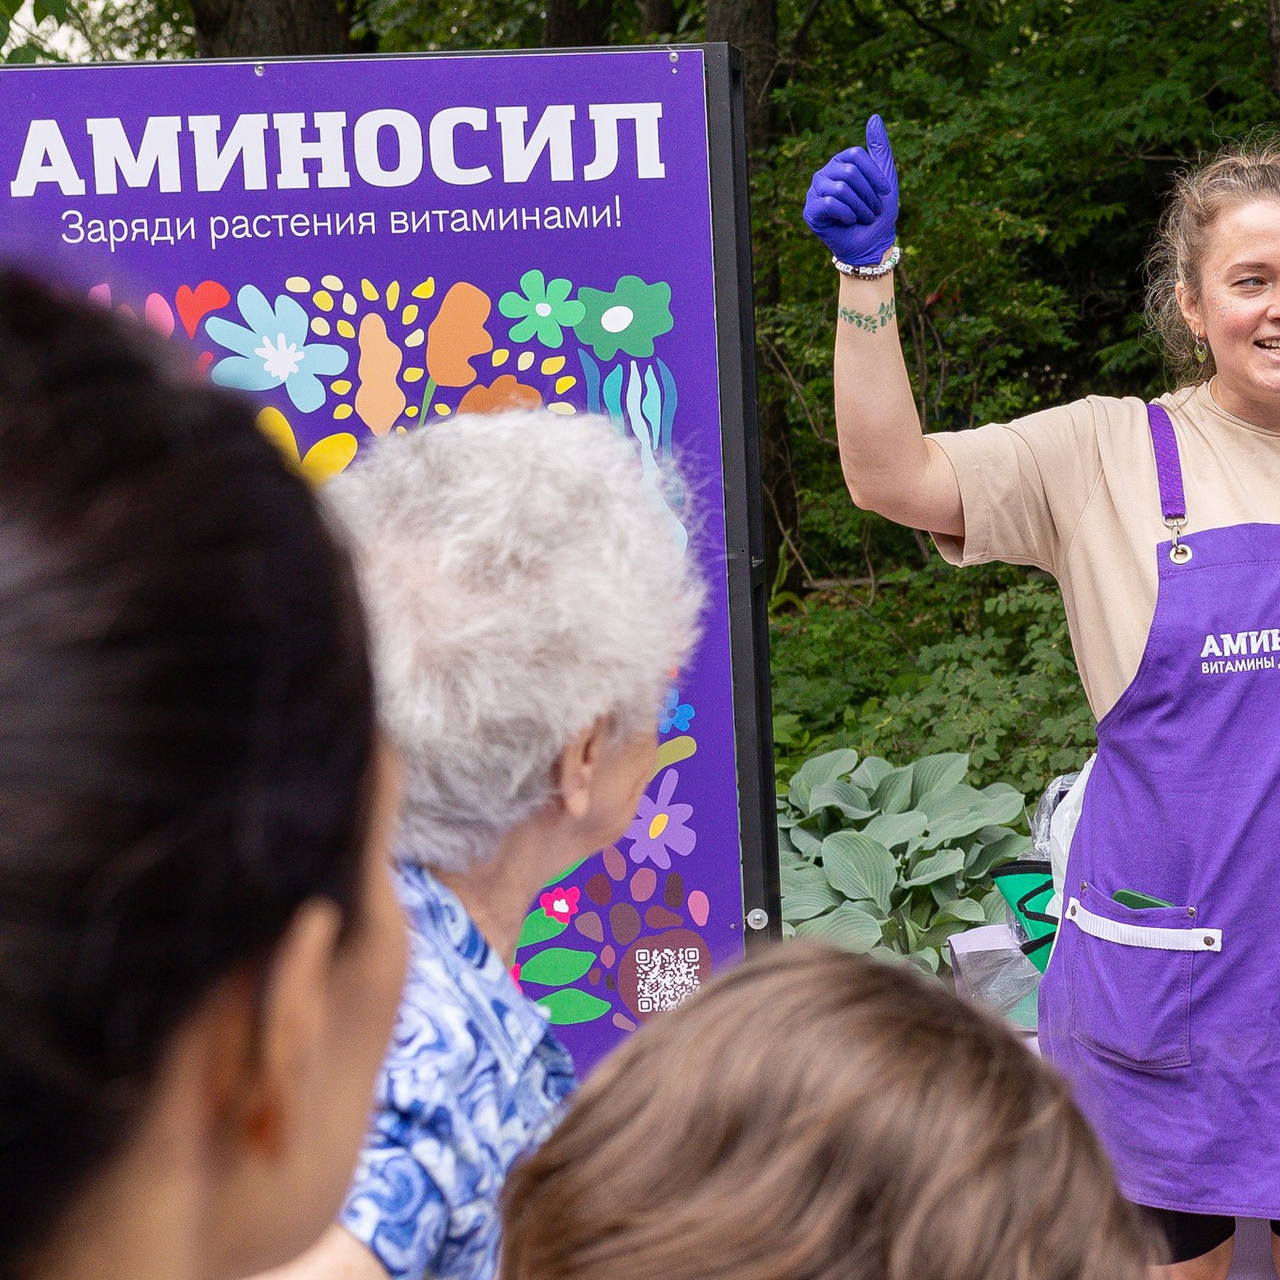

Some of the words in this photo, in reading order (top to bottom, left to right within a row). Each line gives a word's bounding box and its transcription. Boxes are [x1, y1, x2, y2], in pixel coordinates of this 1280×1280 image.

[10, 102, 667, 198] АМИНОСИЛ
[61, 210, 196, 253] Заряди
[209, 208, 377, 250] растения
[389, 195, 623, 236] витаминами!
[1201, 656, 1275, 674] ВИТАМИНЫ
